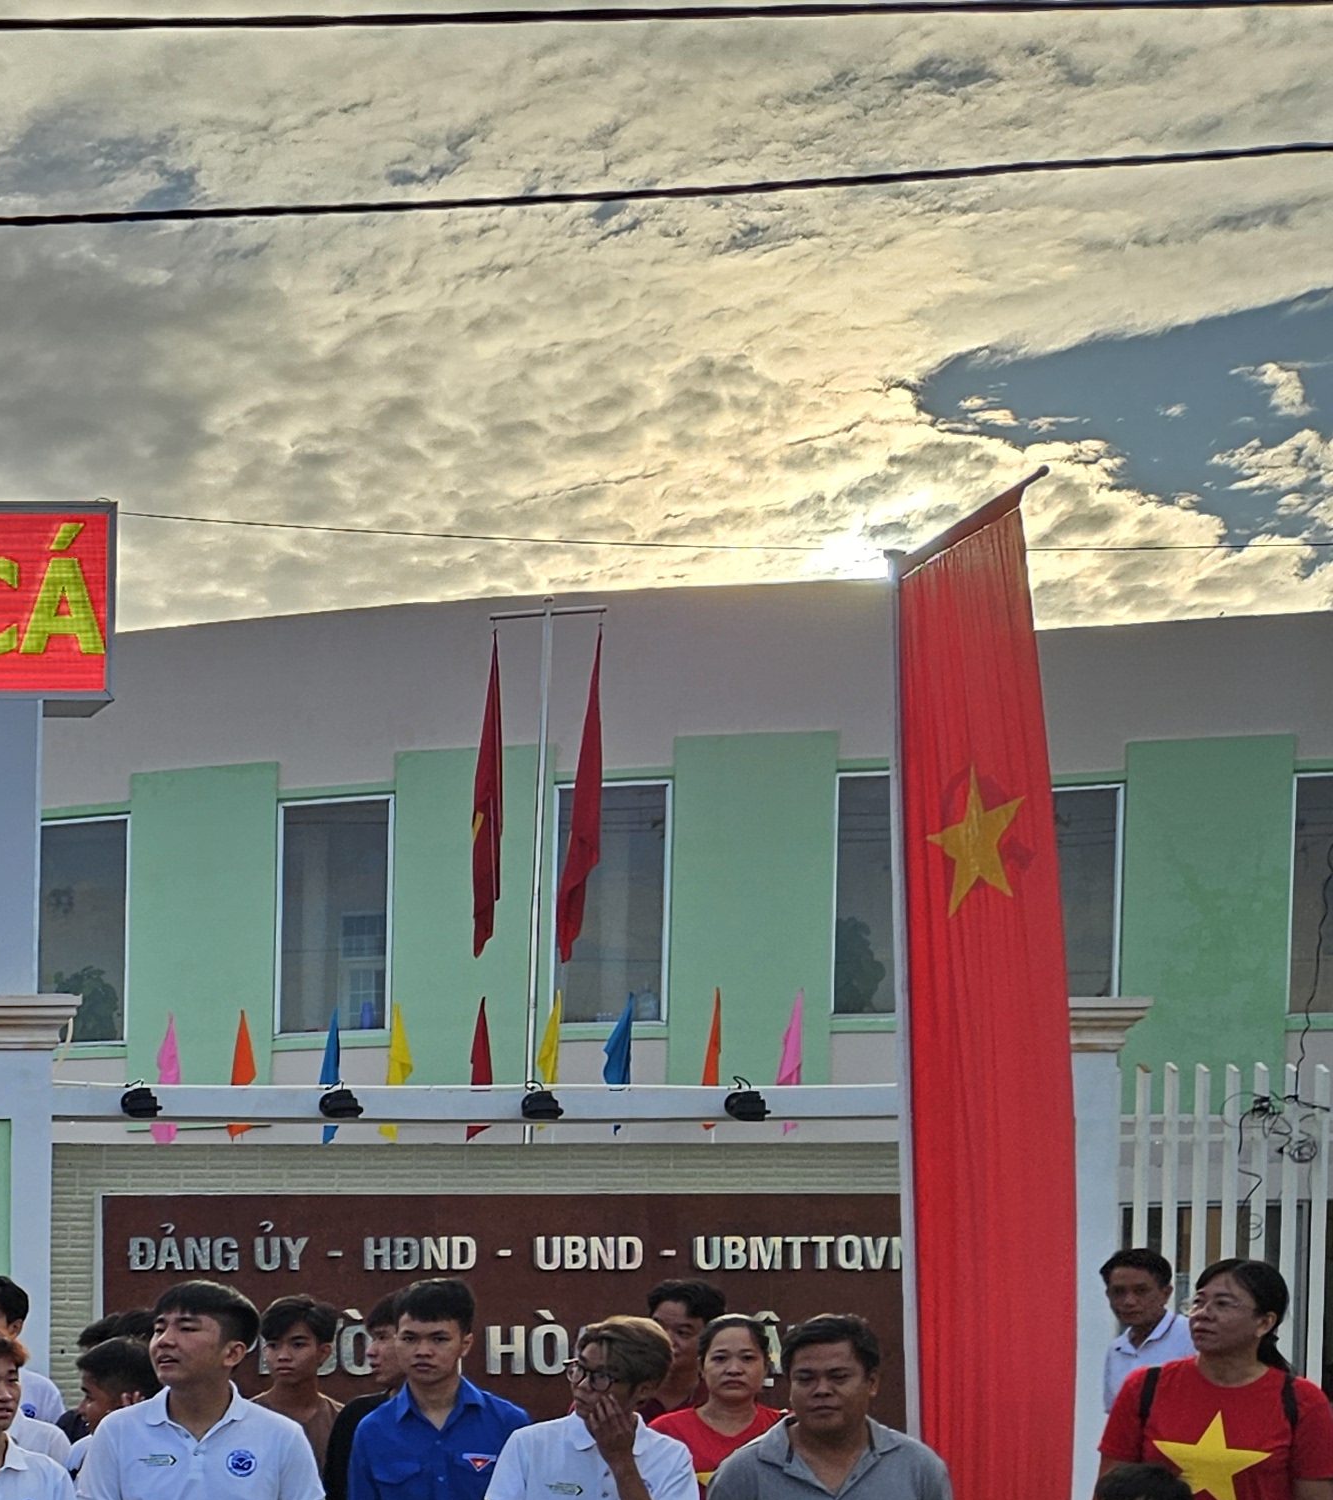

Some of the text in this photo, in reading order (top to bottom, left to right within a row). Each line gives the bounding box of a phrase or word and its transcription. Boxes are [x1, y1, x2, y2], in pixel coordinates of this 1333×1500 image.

[127, 1223, 239, 1271] ĐẢNG
[253, 1220, 309, 1271] ỦY
[327, 1250, 344, 1258] -
[363, 1236, 477, 1271] HĐND
[496, 1249, 512, 1258] -
[534, 1235, 645, 1271] UBND
[659, 1249, 677, 1258] -
[485, 1309, 585, 1376] HÒ
